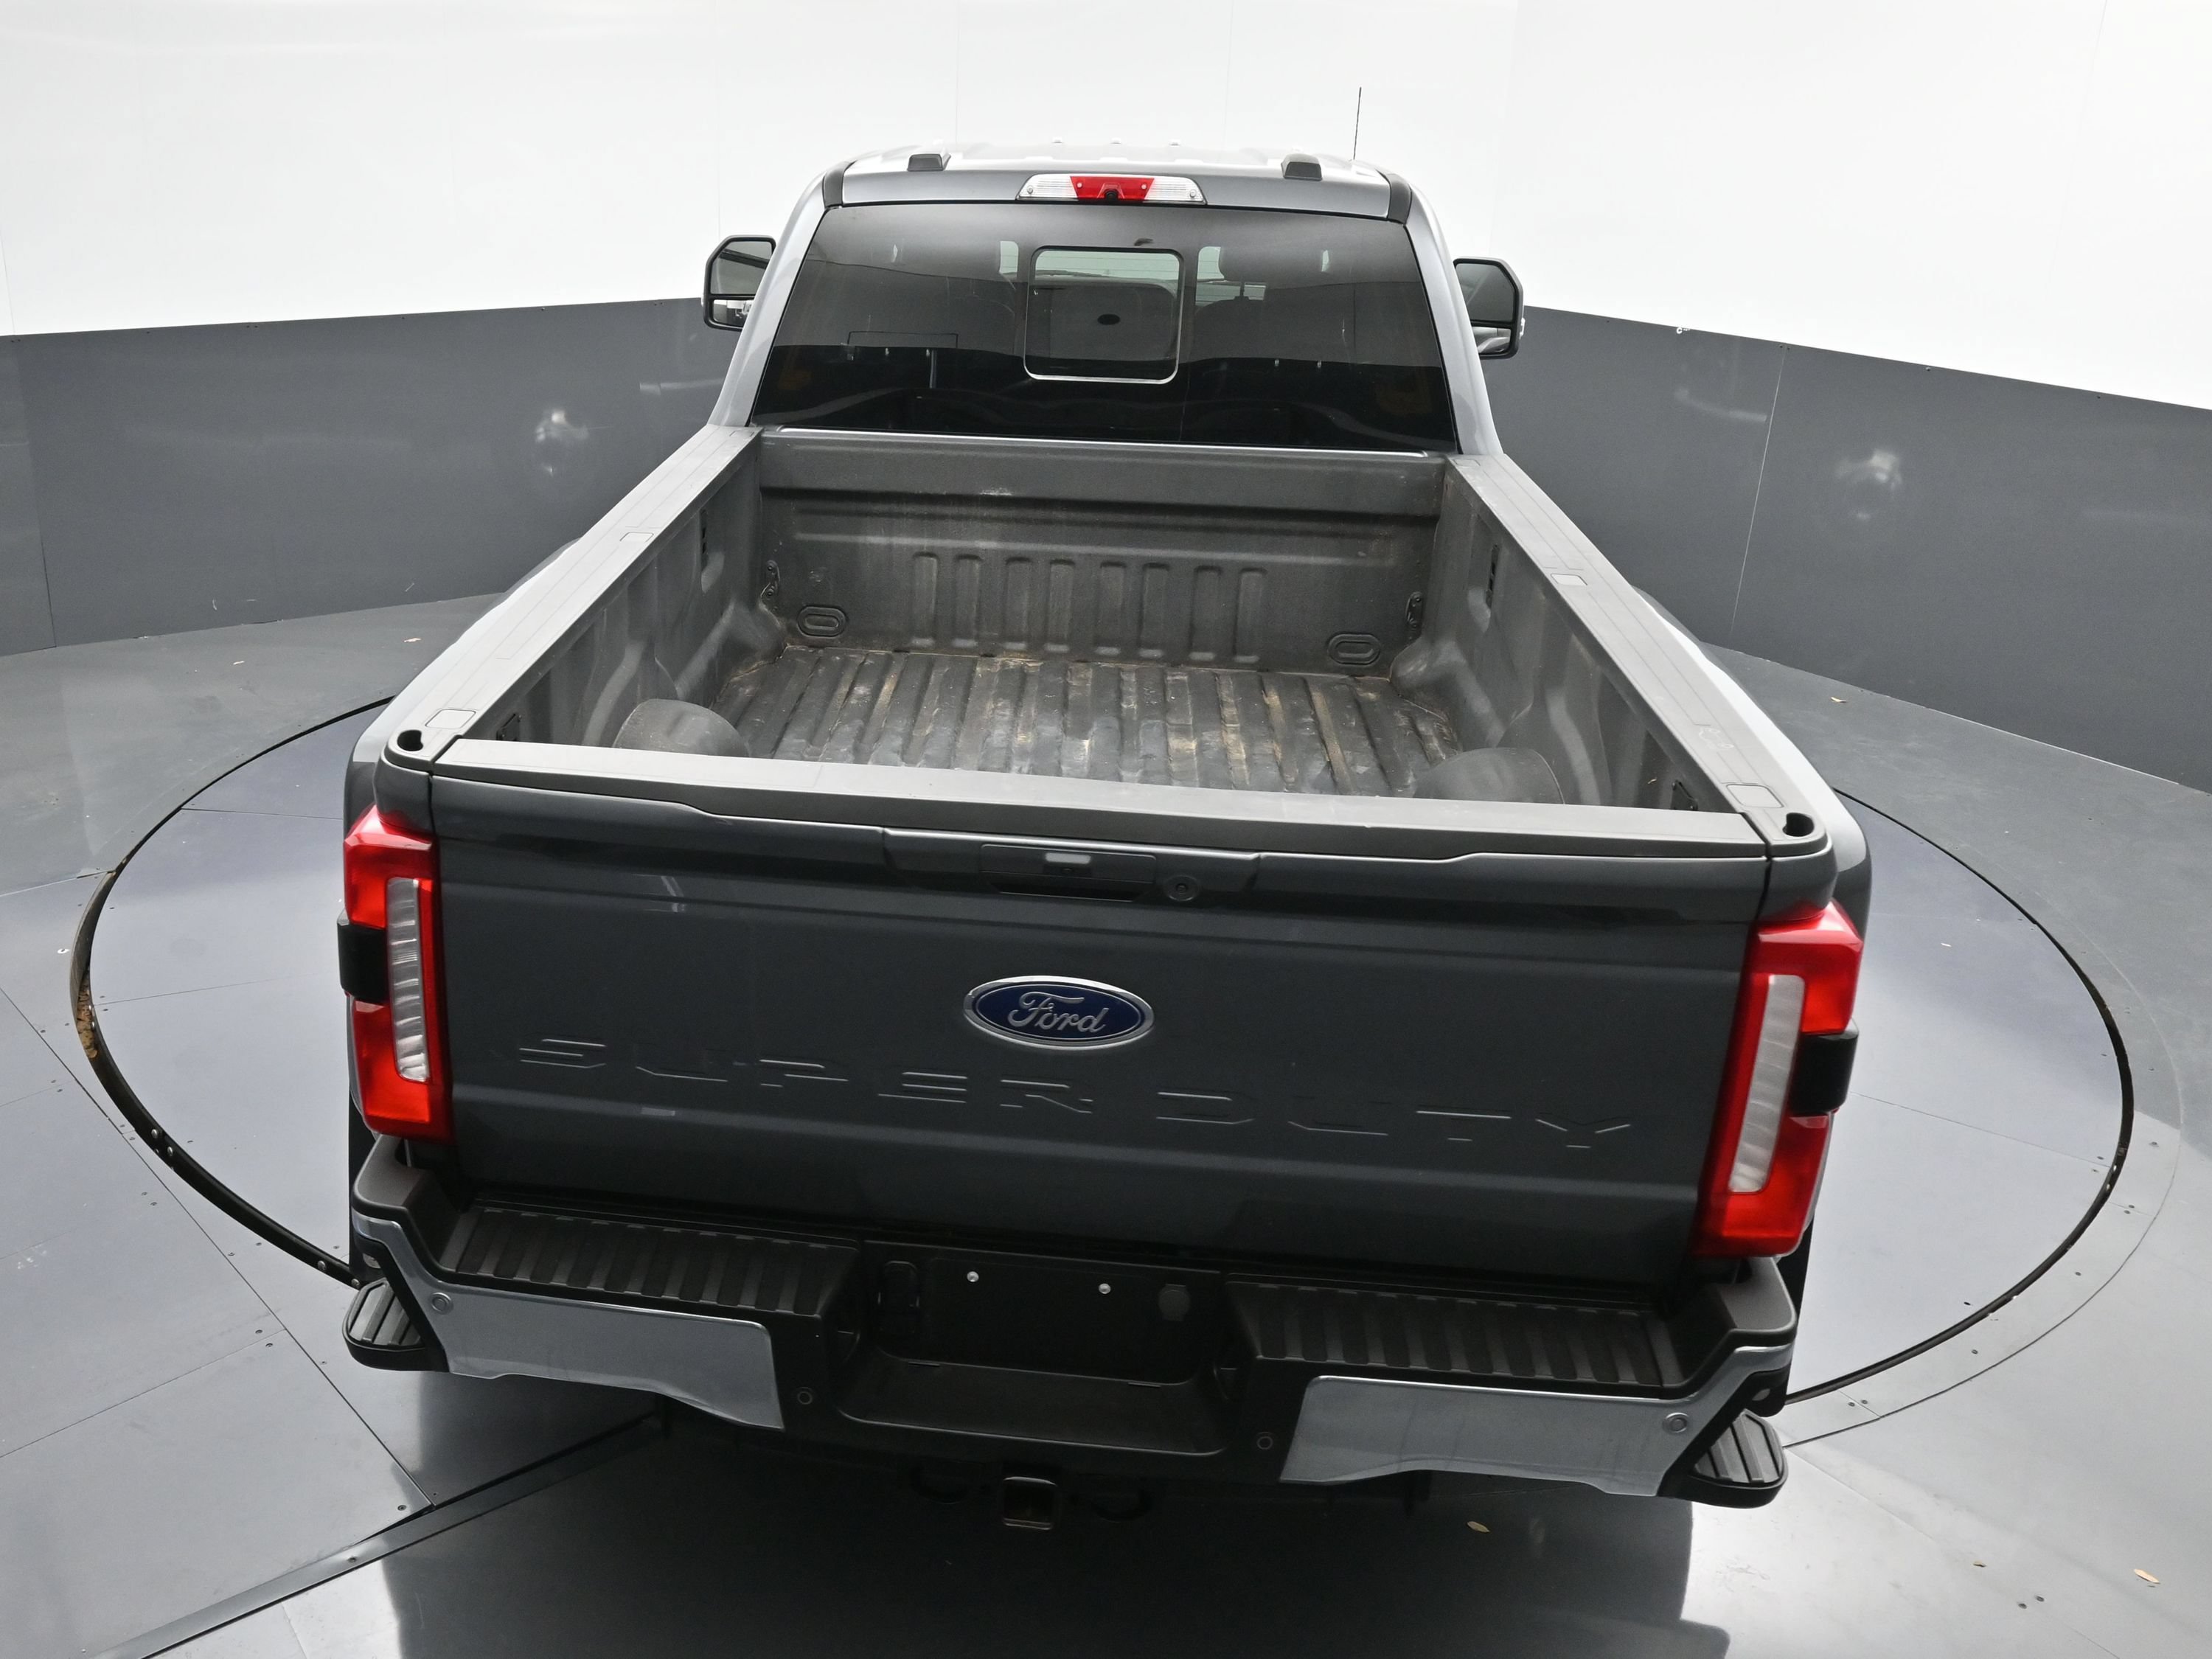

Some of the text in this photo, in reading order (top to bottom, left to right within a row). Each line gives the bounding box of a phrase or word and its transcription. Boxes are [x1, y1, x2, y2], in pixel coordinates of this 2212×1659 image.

[1007, 991, 1109, 1033] Ford
[518, 1039, 1632, 1149] SUPER DUTY
